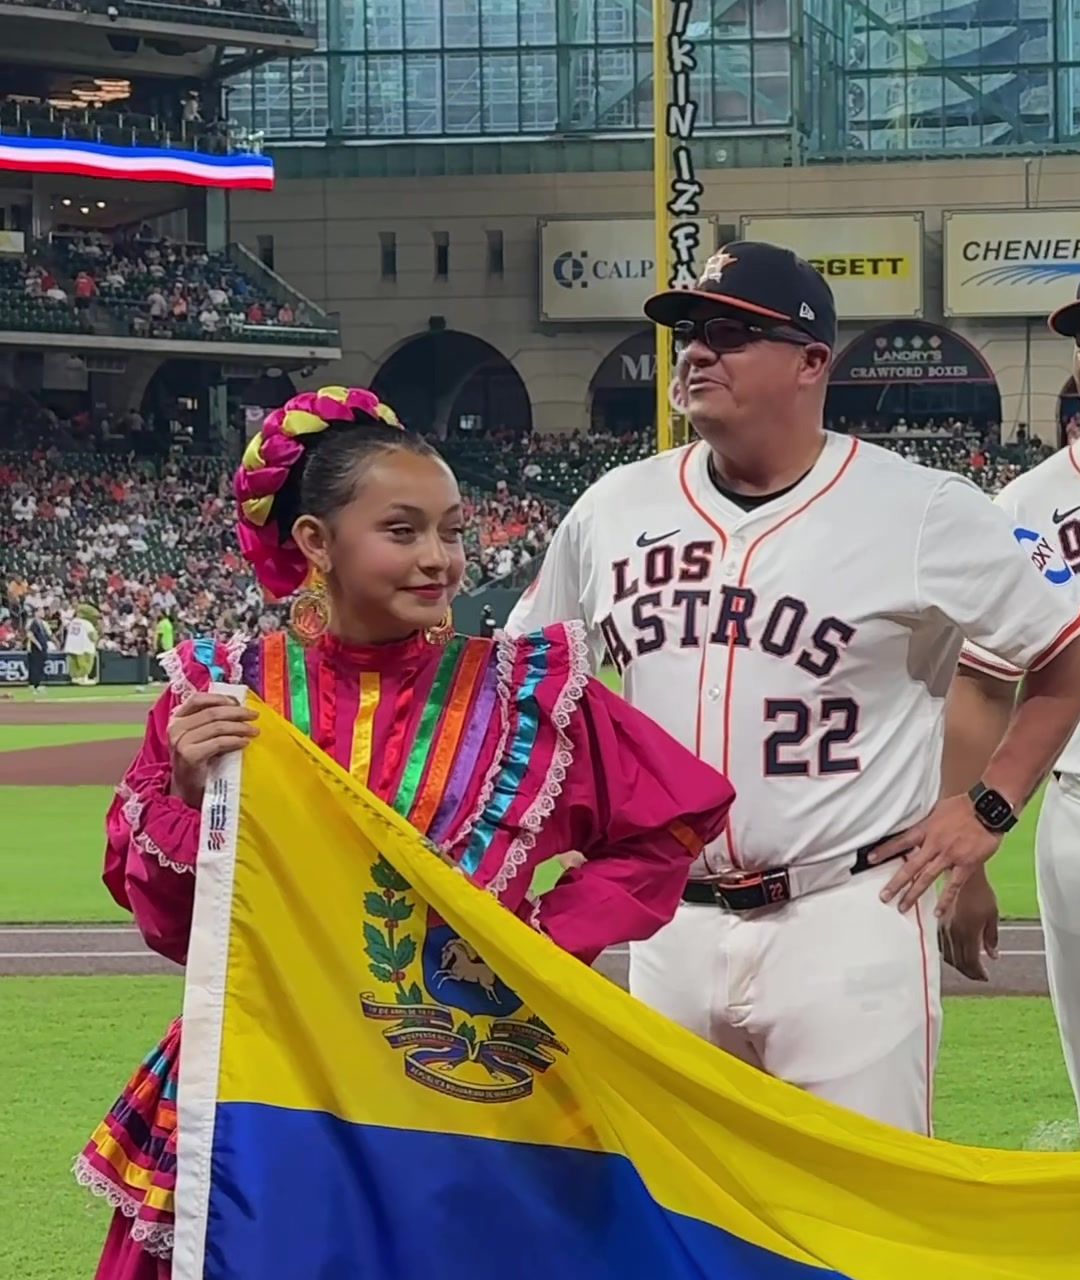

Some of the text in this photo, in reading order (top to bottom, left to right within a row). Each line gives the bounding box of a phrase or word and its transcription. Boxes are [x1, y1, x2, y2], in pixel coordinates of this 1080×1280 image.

[851, 366, 968, 378] CRAWFORD BOXES
[873, 350, 942, 362] LANDRY'S
[612, 539, 715, 604] LOS
[1031, 537, 1054, 572] OXY
[601, 585, 857, 680] ASTROS
[763, 696, 861, 778] 22
